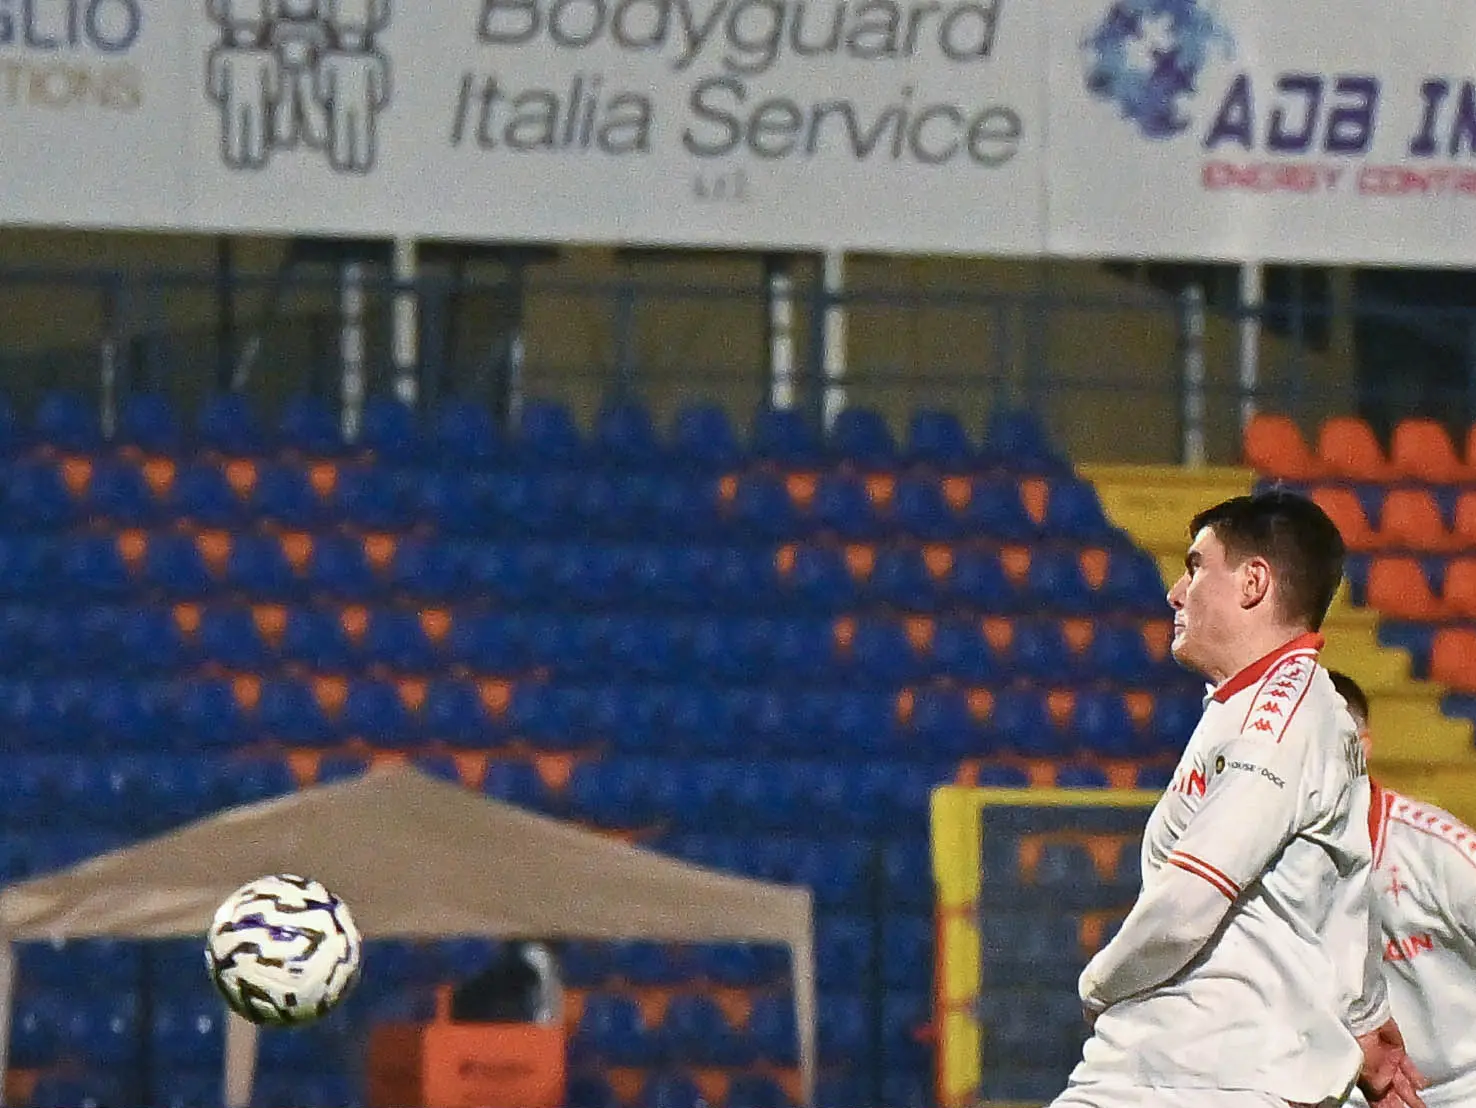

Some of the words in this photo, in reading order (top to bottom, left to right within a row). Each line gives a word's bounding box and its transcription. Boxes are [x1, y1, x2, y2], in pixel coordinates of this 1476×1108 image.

[477, 0, 1000, 74] Bodyguard
[450, 71, 655, 155] Italia
[681, 75, 1024, 165] Service
